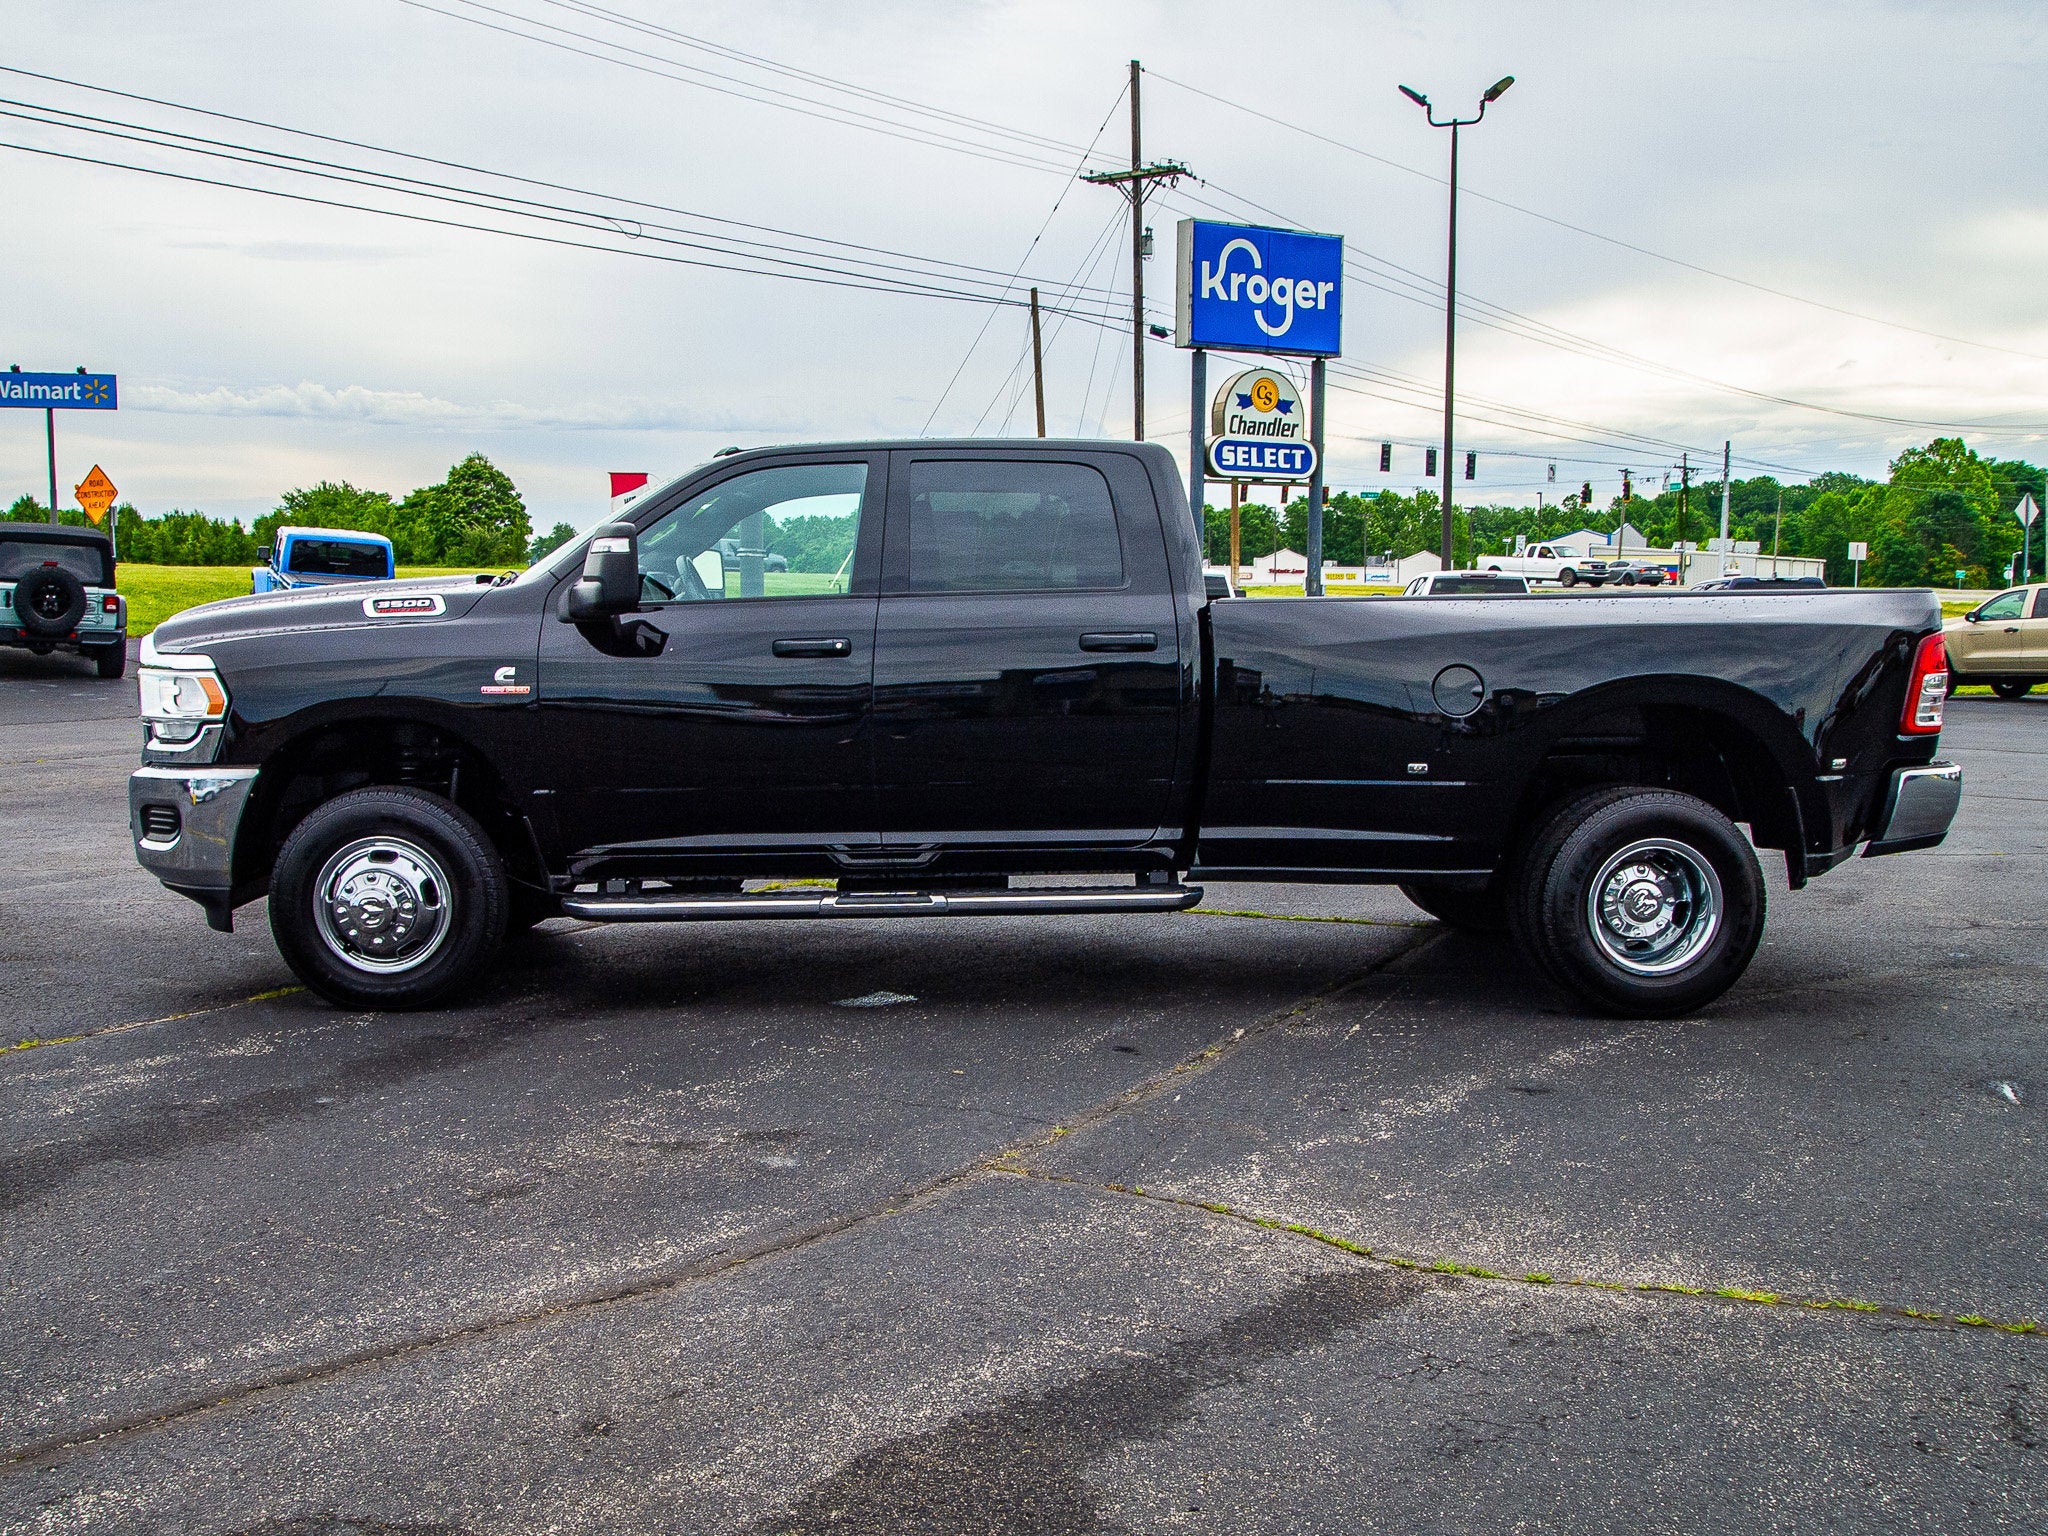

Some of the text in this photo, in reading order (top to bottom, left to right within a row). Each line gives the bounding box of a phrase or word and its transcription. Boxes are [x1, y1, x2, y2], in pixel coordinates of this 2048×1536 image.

[1201, 238, 1334, 337] Kroger
[1229, 414, 1300, 438] Chandler
[1221, 445, 1306, 469] SELECT
[88, 479, 104, 487] ROAD
[75, 489, 115, 499] CONSTRUCTION
[377, 599, 431, 609] 3500
